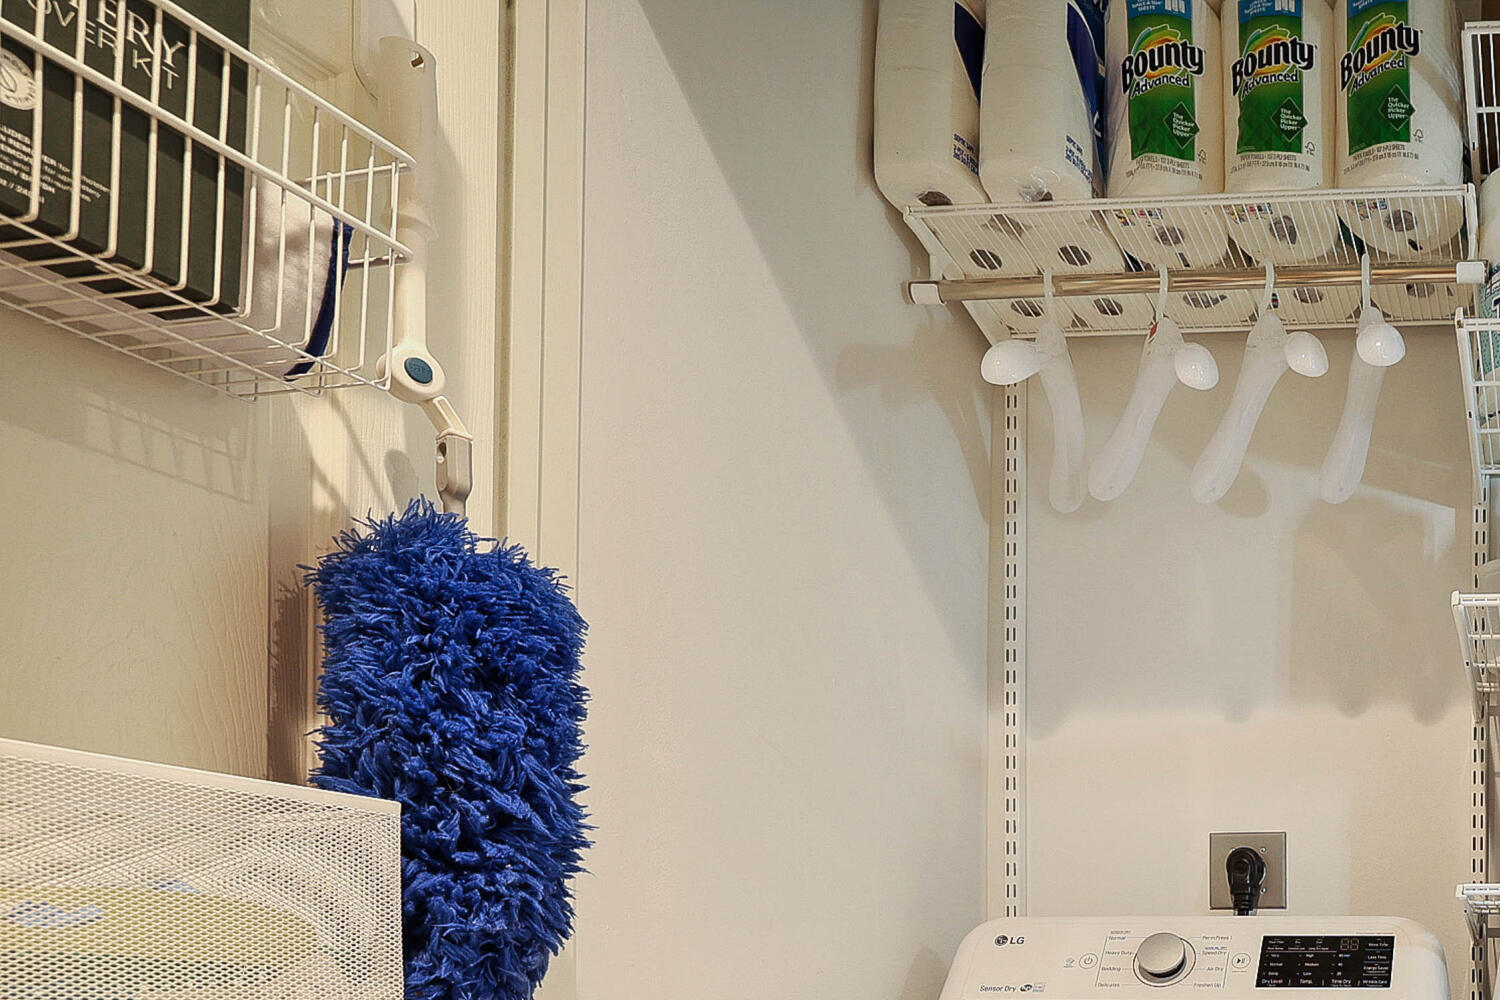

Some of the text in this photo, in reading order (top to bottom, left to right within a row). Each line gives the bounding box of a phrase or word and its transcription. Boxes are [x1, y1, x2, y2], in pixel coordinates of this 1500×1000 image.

[132, 49, 181, 90] KT
[1121, 39, 1205, 94] Bounty
[1231, 36, 1314, 96] Bounty
[1340, 21, 1420, 92] Bounty
[1130, 74, 1190, 98] Advanced
[1240, 71, 1299, 100] Advanced
[1349, 57, 1406, 96] Advanced
[1173, 118, 1195, 127] Quicker
[1173, 124, 1190, 132] Picker
[1280, 113, 1301, 121] Quicker
[1009, 936, 1025, 945] LG
